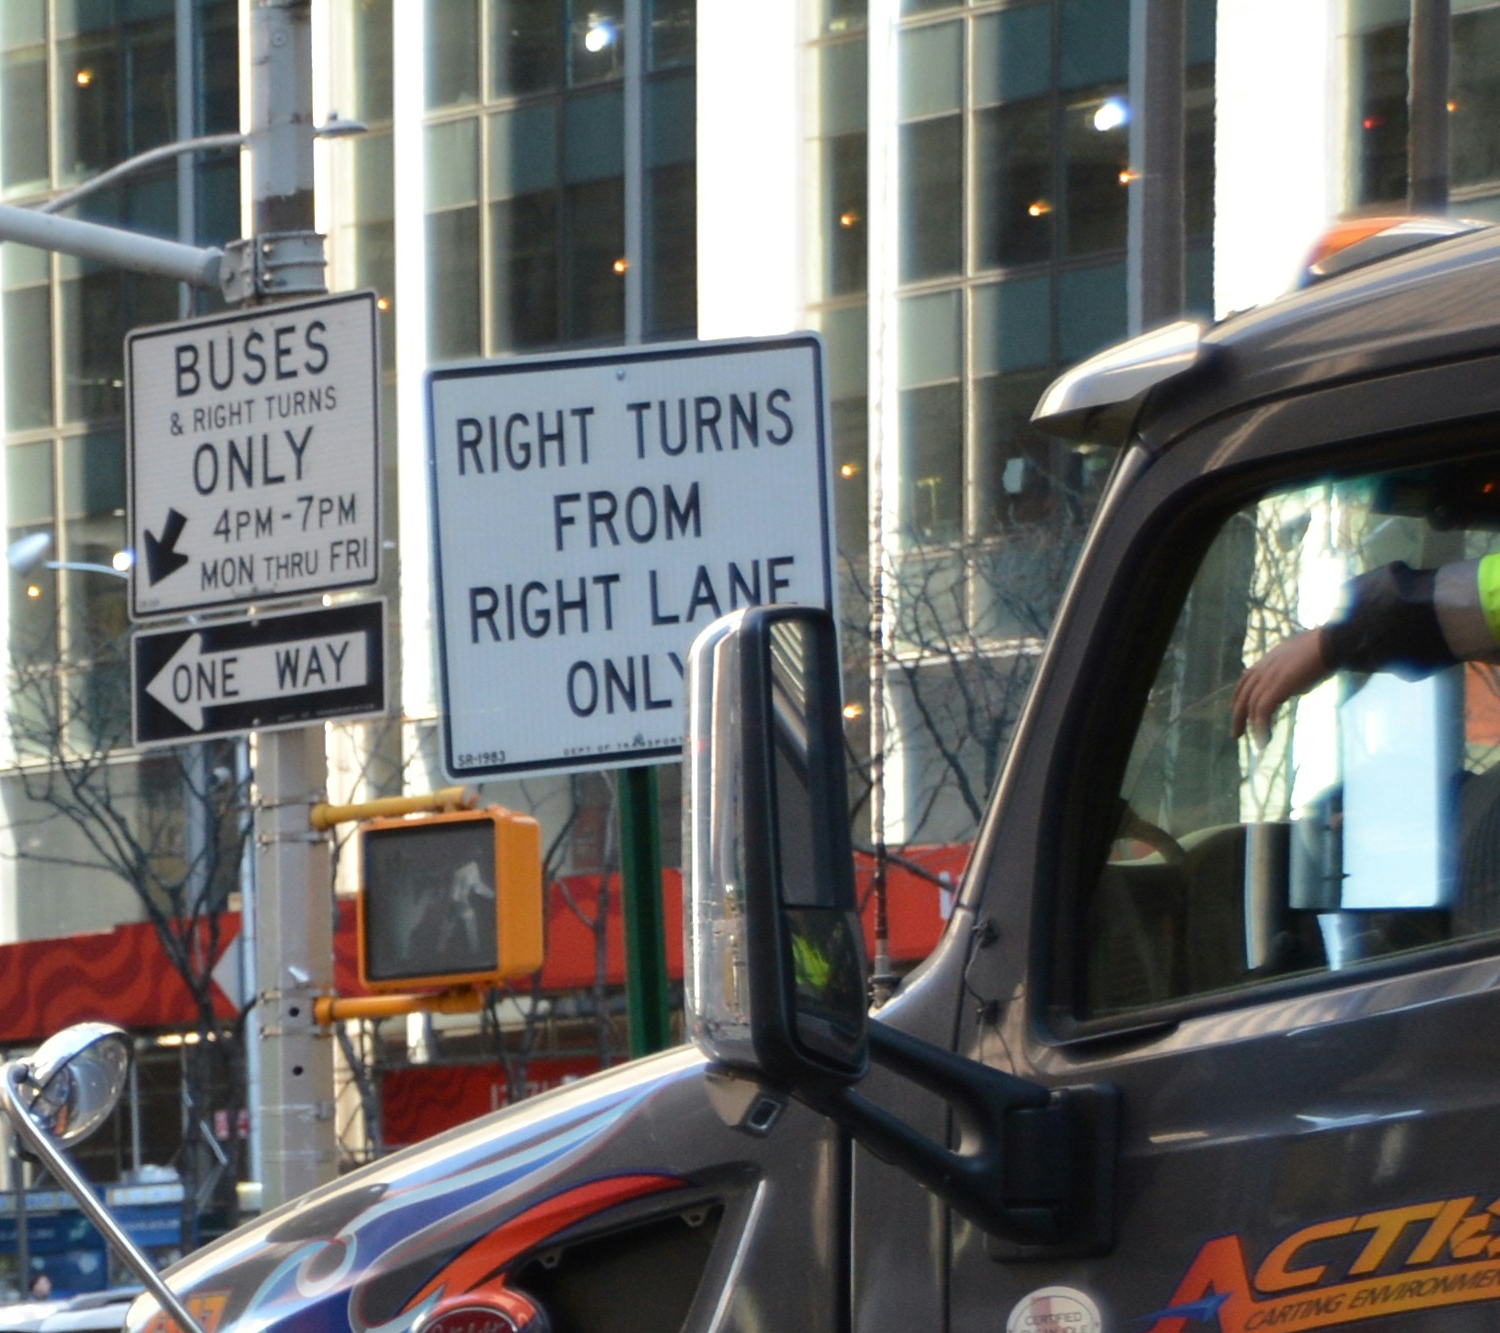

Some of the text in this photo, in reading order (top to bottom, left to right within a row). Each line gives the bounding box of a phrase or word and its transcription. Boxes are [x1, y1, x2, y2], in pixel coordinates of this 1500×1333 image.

[175, 321, 329, 397] BUSES
[170, 386, 337, 436] & RIGHT TURNS
[456, 388, 794, 476] RIGHT TURNS
[193, 426, 313, 496] ONLY
[553, 481, 701, 551] FROM
[201, 537, 368, 591] MON THRU FRI
[469, 574, 620, 643] RIGHT
[172, 641, 349, 704] ONE WAY
[1244, 1292, 1342, 1332] CARTING
